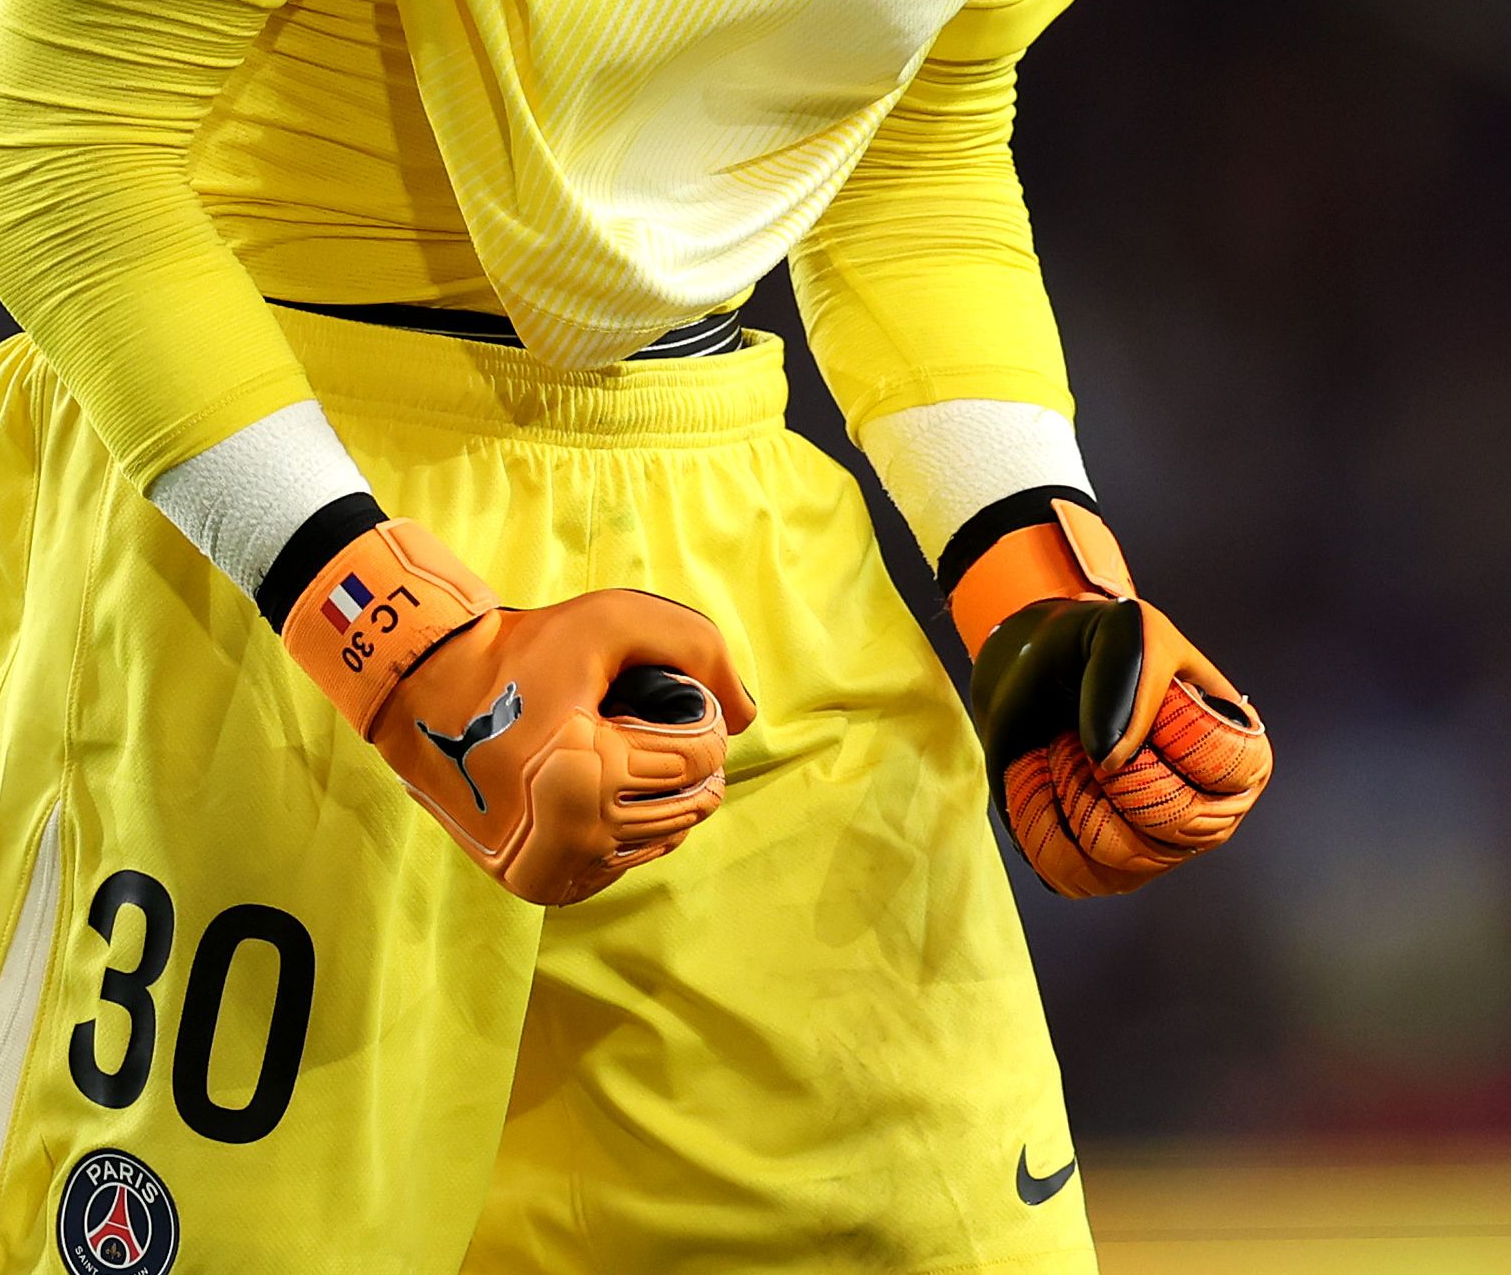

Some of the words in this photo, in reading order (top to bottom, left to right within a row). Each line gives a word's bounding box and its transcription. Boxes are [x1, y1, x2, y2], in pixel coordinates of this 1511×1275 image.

[371, 585, 420, 634] LC
[342, 631, 375, 673] 30
[68, 869, 317, 1145] 30
[85, 1160, 159, 1205] PARIS
